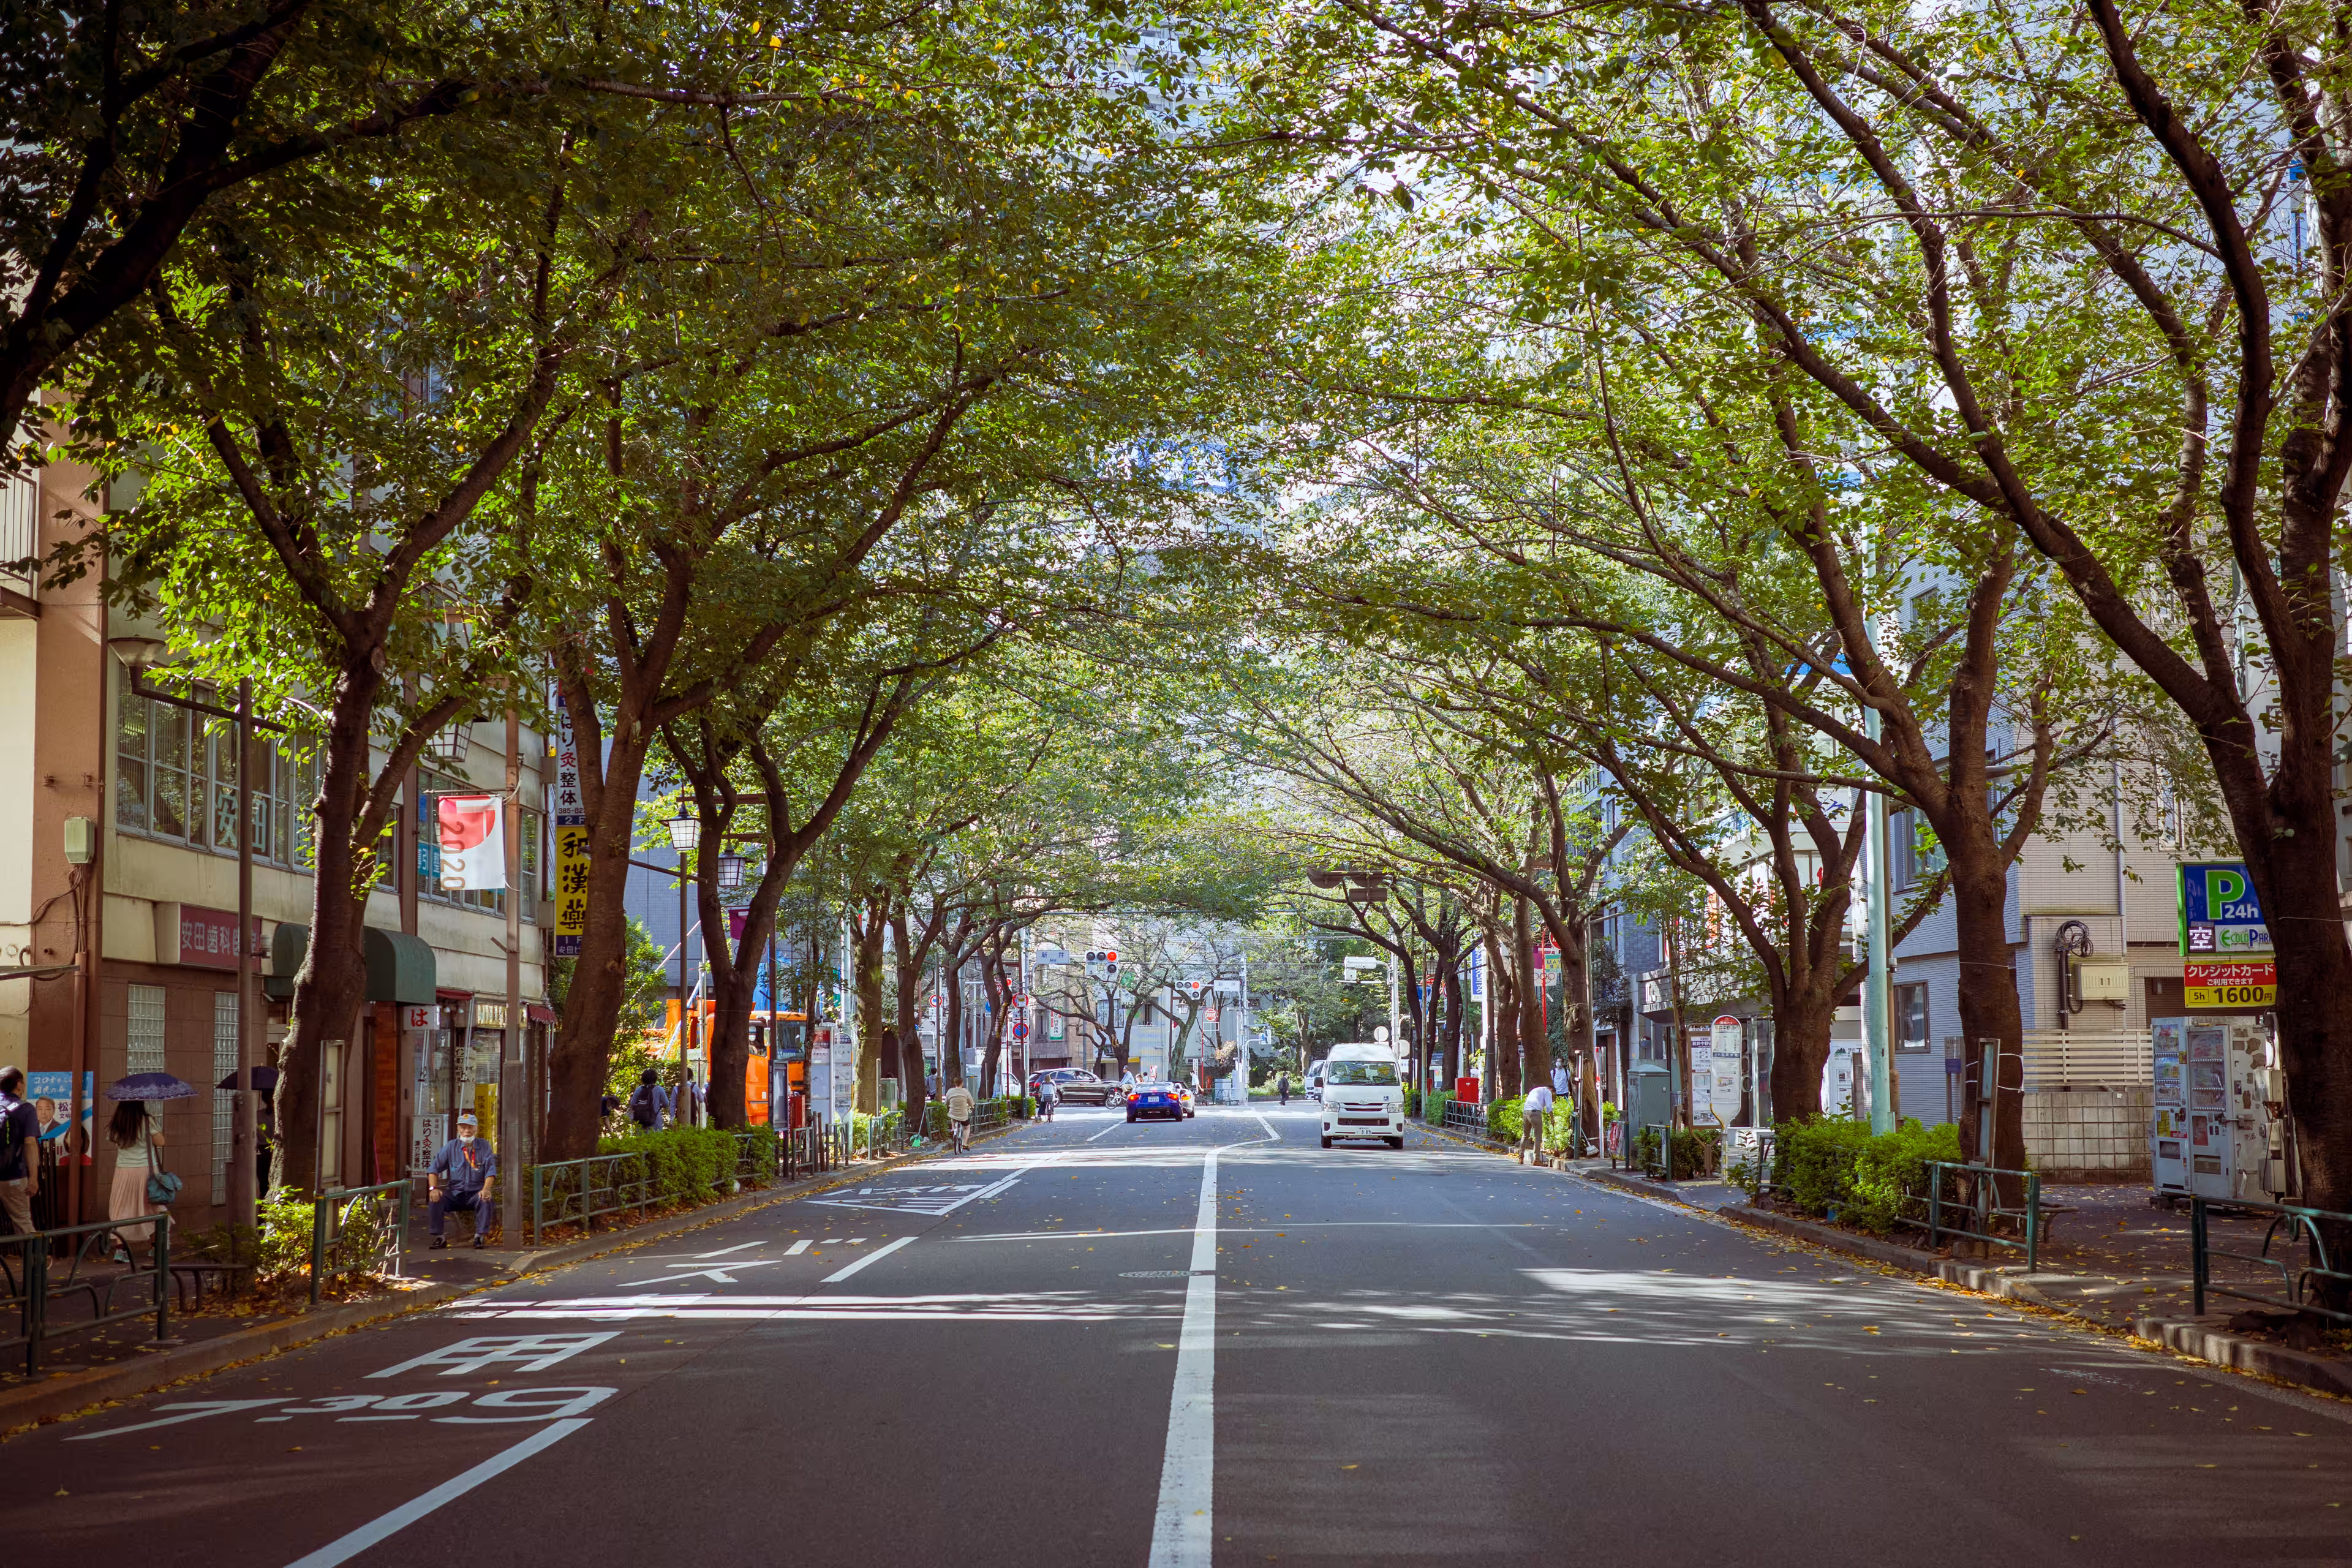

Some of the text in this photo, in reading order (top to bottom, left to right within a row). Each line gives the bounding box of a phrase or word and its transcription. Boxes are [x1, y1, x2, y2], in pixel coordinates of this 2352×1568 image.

[440, 821, 466, 891] 2020
[2205, 869, 2246, 920] P
[2224, 903, 2260, 919] 24h
[2189, 927, 2213, 949] 空
[2187, 963, 2274, 978] クレジットカード
[2193, 992, 2206, 1000] 5h
[58, 1101, 72, 1112] 松
